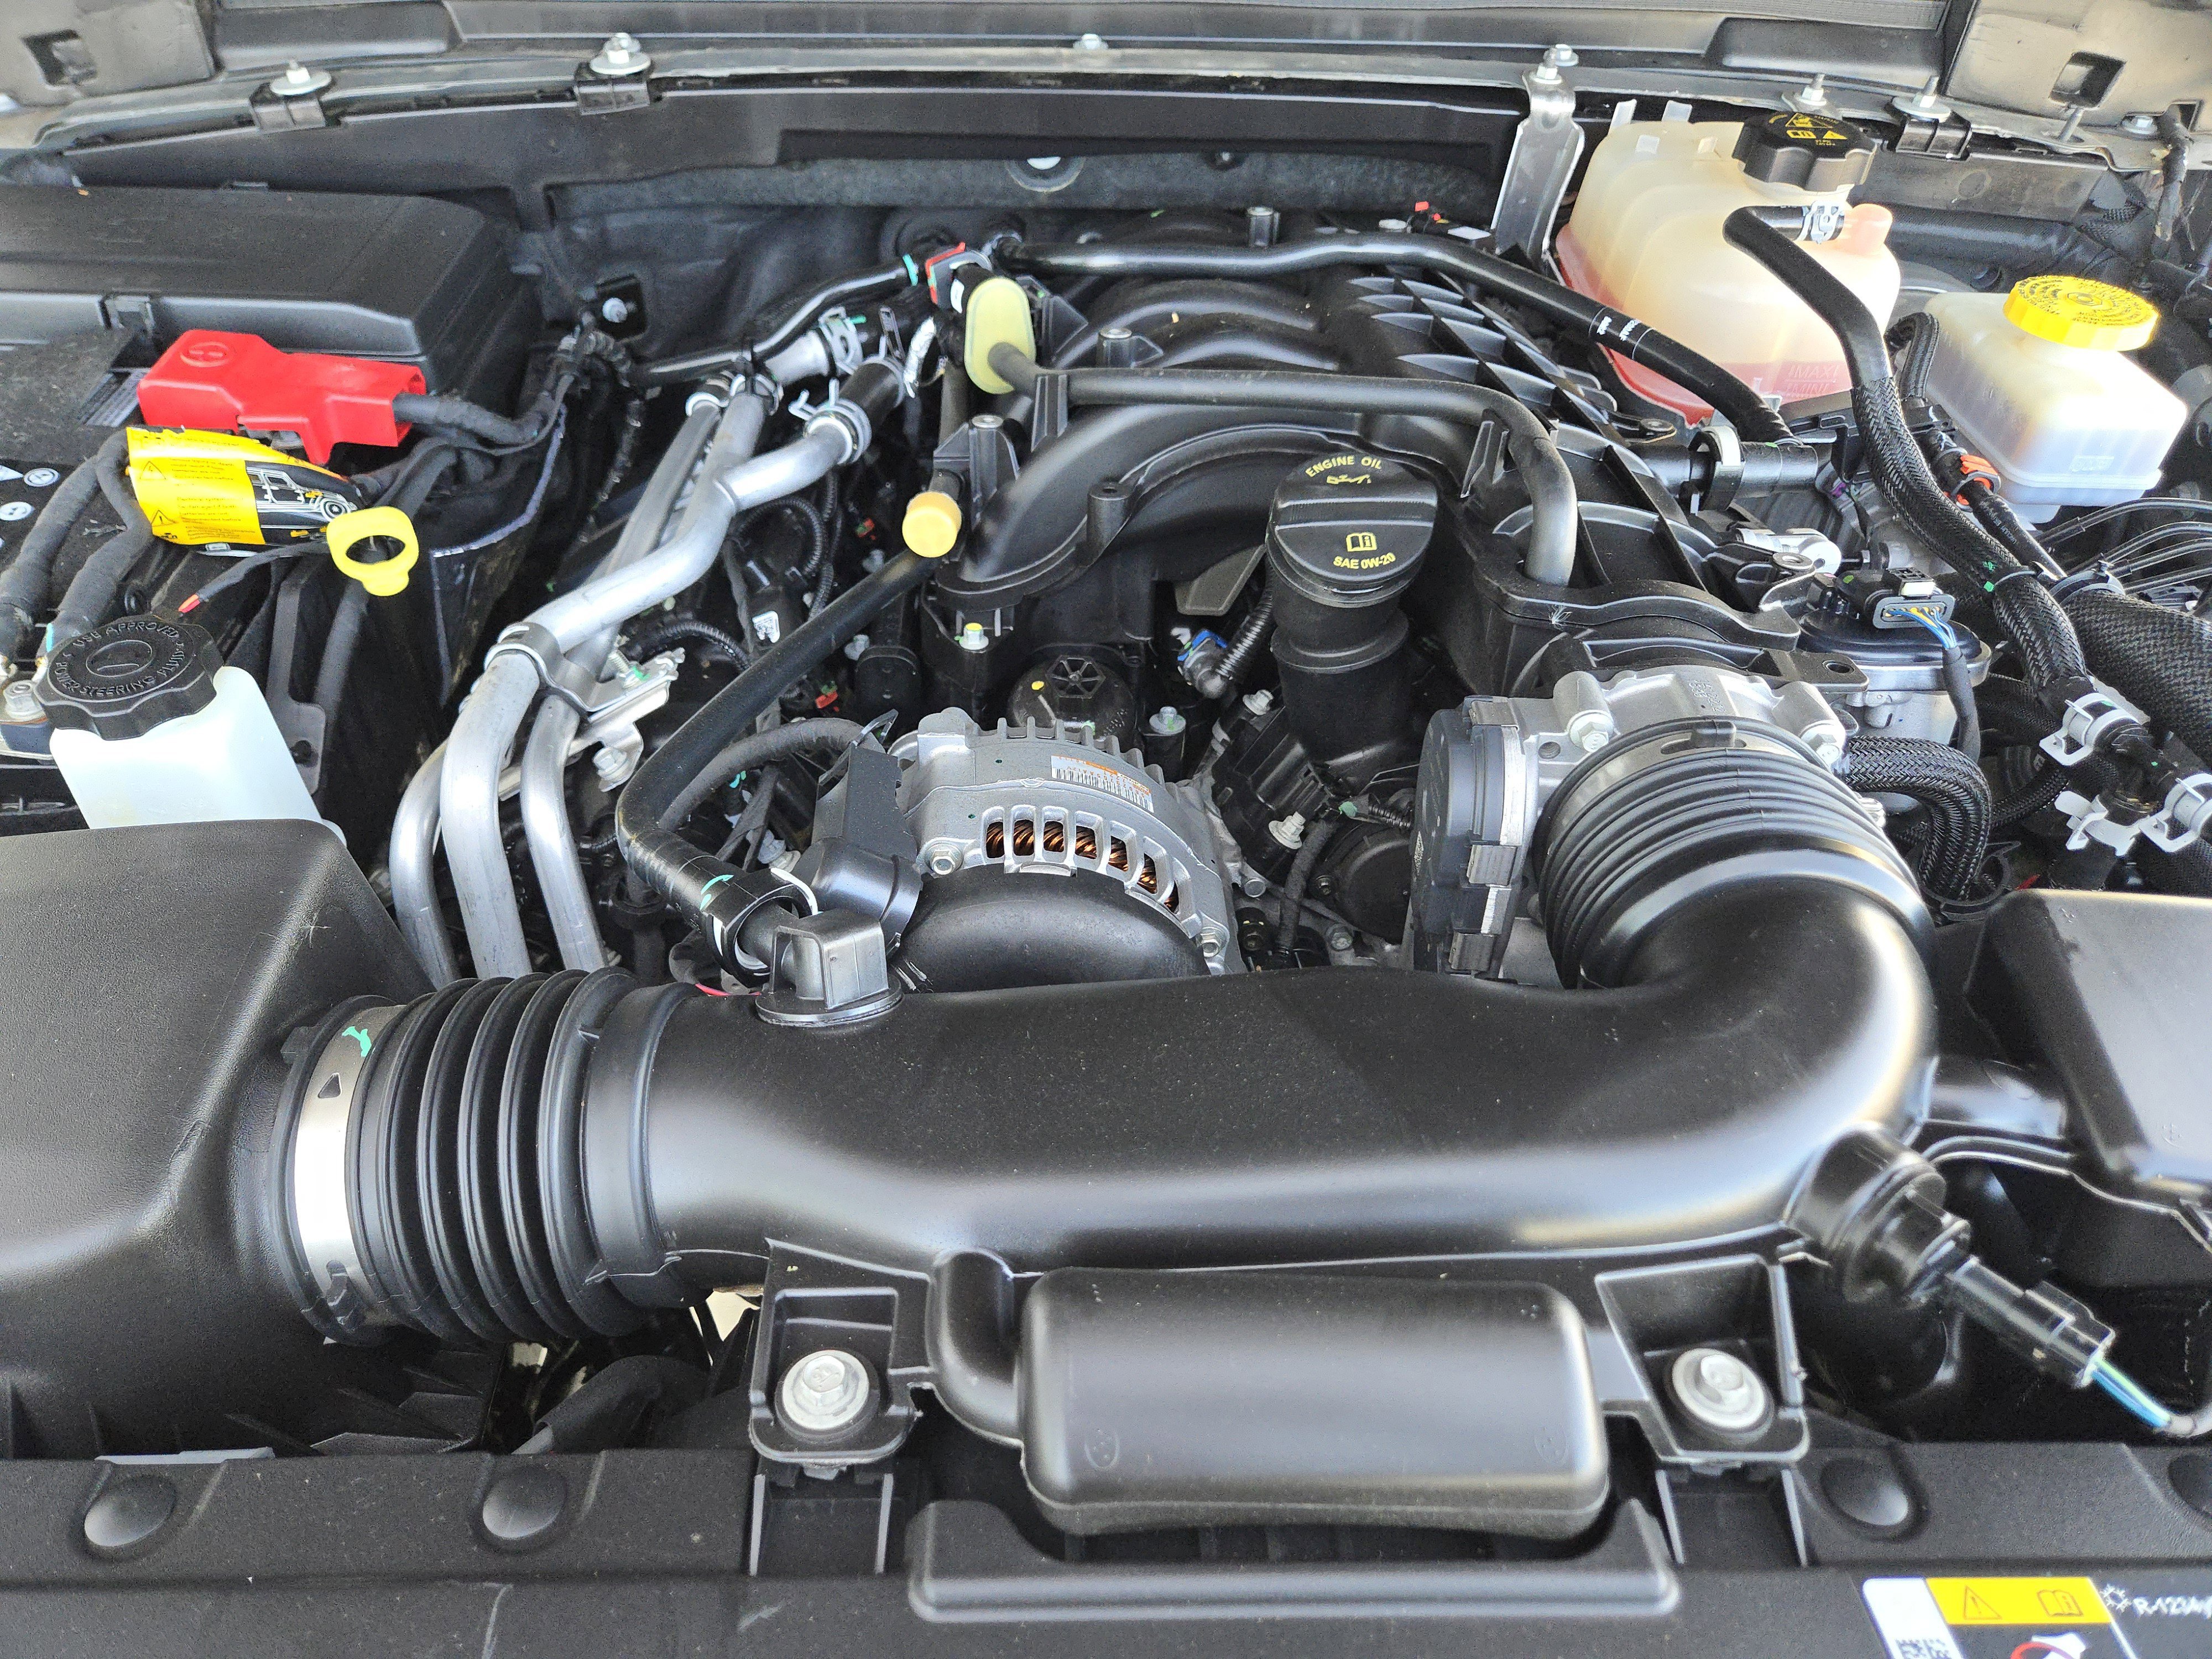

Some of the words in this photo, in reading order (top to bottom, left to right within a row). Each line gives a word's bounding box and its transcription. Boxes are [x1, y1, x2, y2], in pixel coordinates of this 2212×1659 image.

[1305, 455, 1355, 477] ENGINE
[1361, 456, 1383, 470] OIL
[1333, 555, 1360, 570] SAE
[1360, 551, 1397, 570] 0W-20
[72, 631, 102, 648] USE
[105, 621, 180, 639] APPROVED
[54, 661, 81, 692] POWER
[79, 675, 156, 697] STEERING
